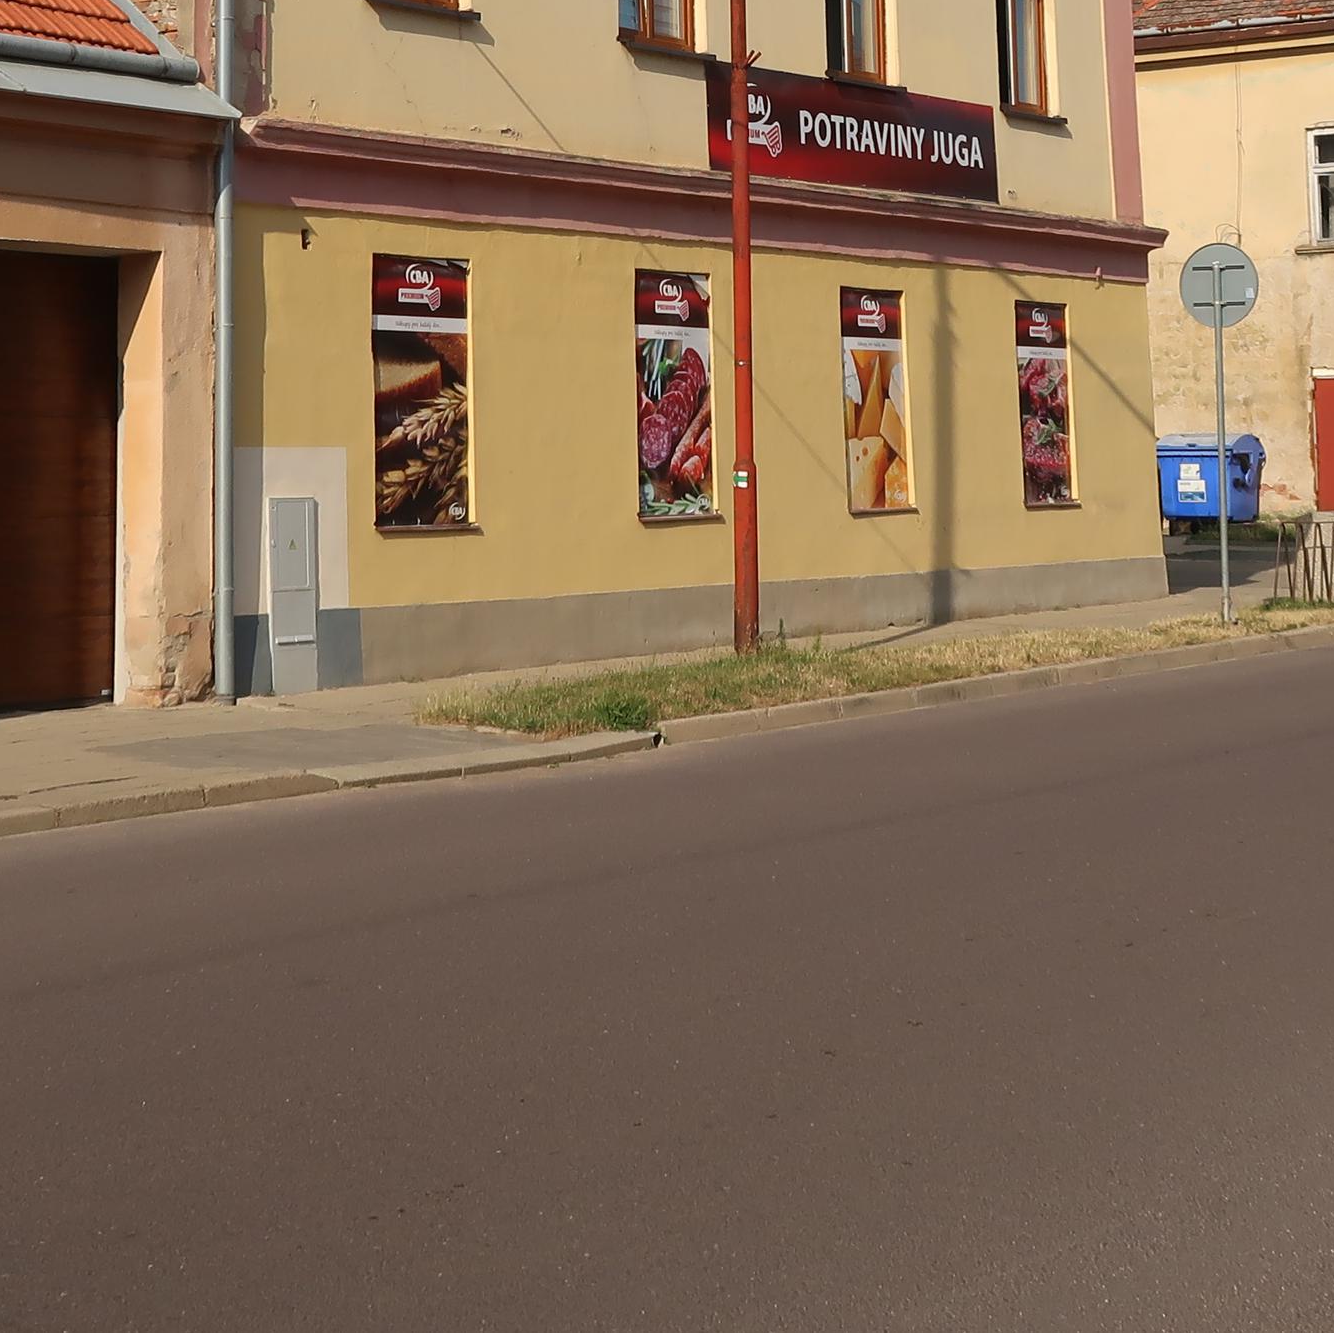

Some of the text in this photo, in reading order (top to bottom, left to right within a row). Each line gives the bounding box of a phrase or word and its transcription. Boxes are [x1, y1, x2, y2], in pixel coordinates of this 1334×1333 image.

[799, 109, 984, 169] POTRAVINY JUGA
[410, 270, 429, 284] CBA
[663, 285, 678, 297] CBA
